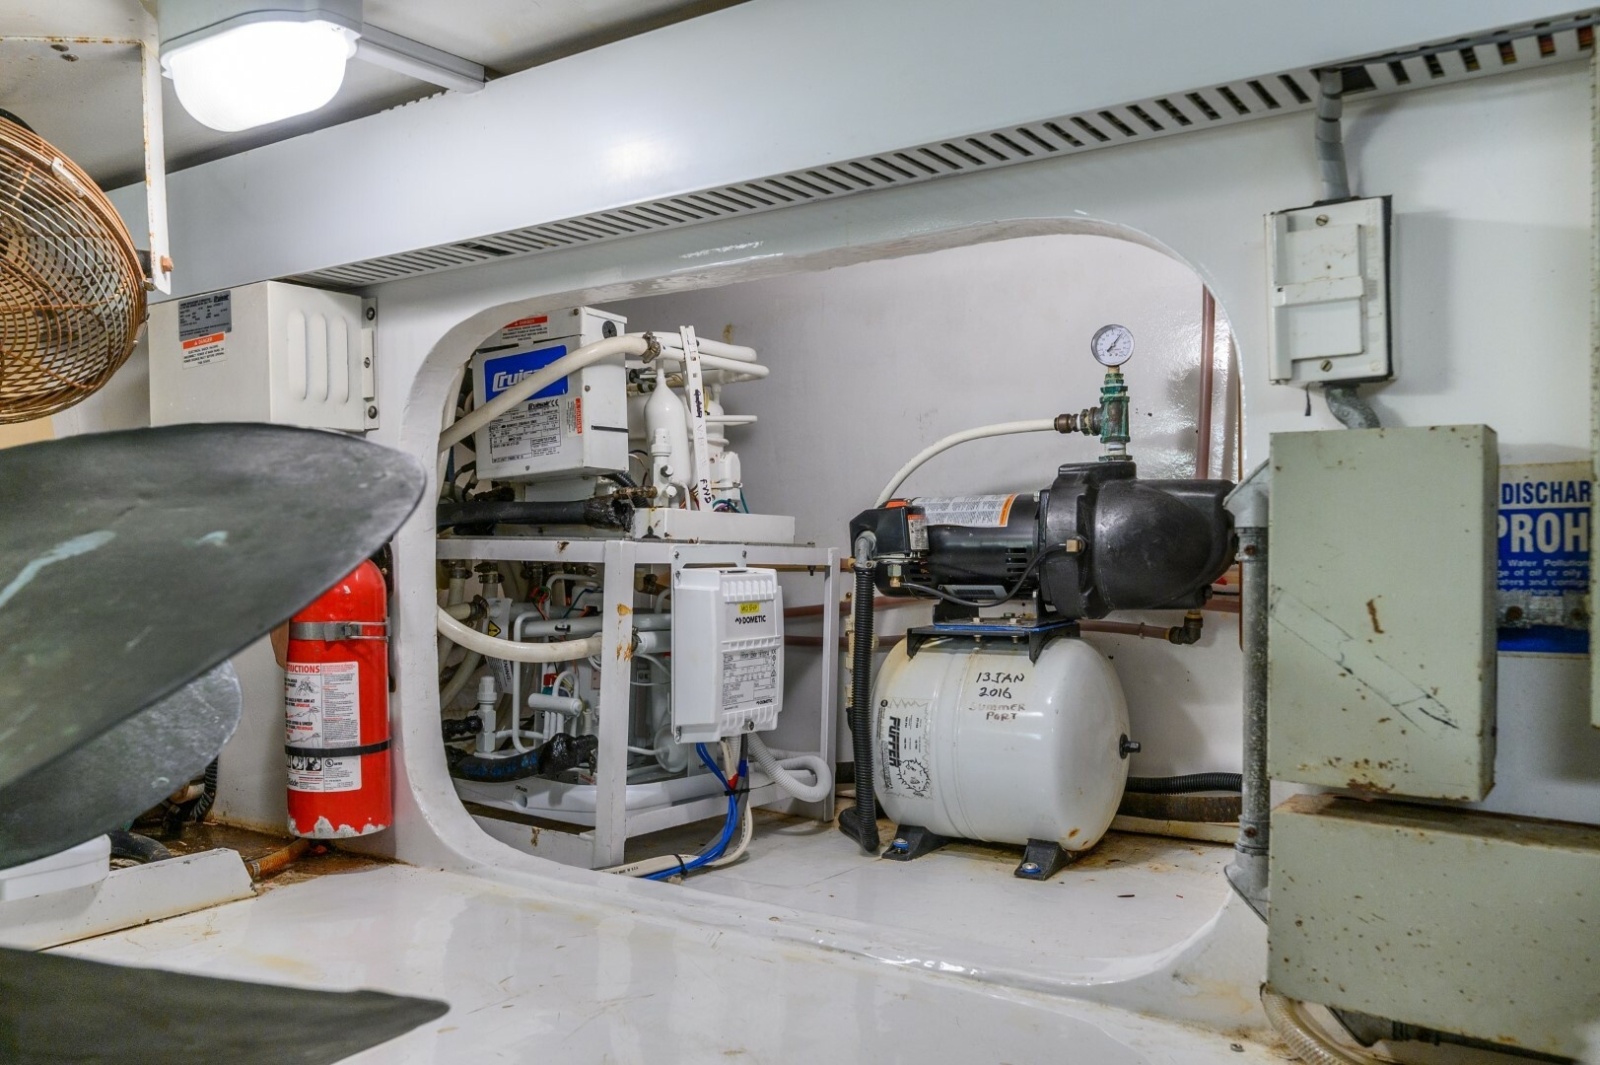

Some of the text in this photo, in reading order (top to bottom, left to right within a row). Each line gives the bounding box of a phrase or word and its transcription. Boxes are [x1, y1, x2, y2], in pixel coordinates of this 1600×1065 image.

[1508, 559, 1537, 567] Water
[742, 615, 766, 624] DOMETIC
[978, 687, 1012, 699] 2016
[889, 716, 901, 768] PUFFER
